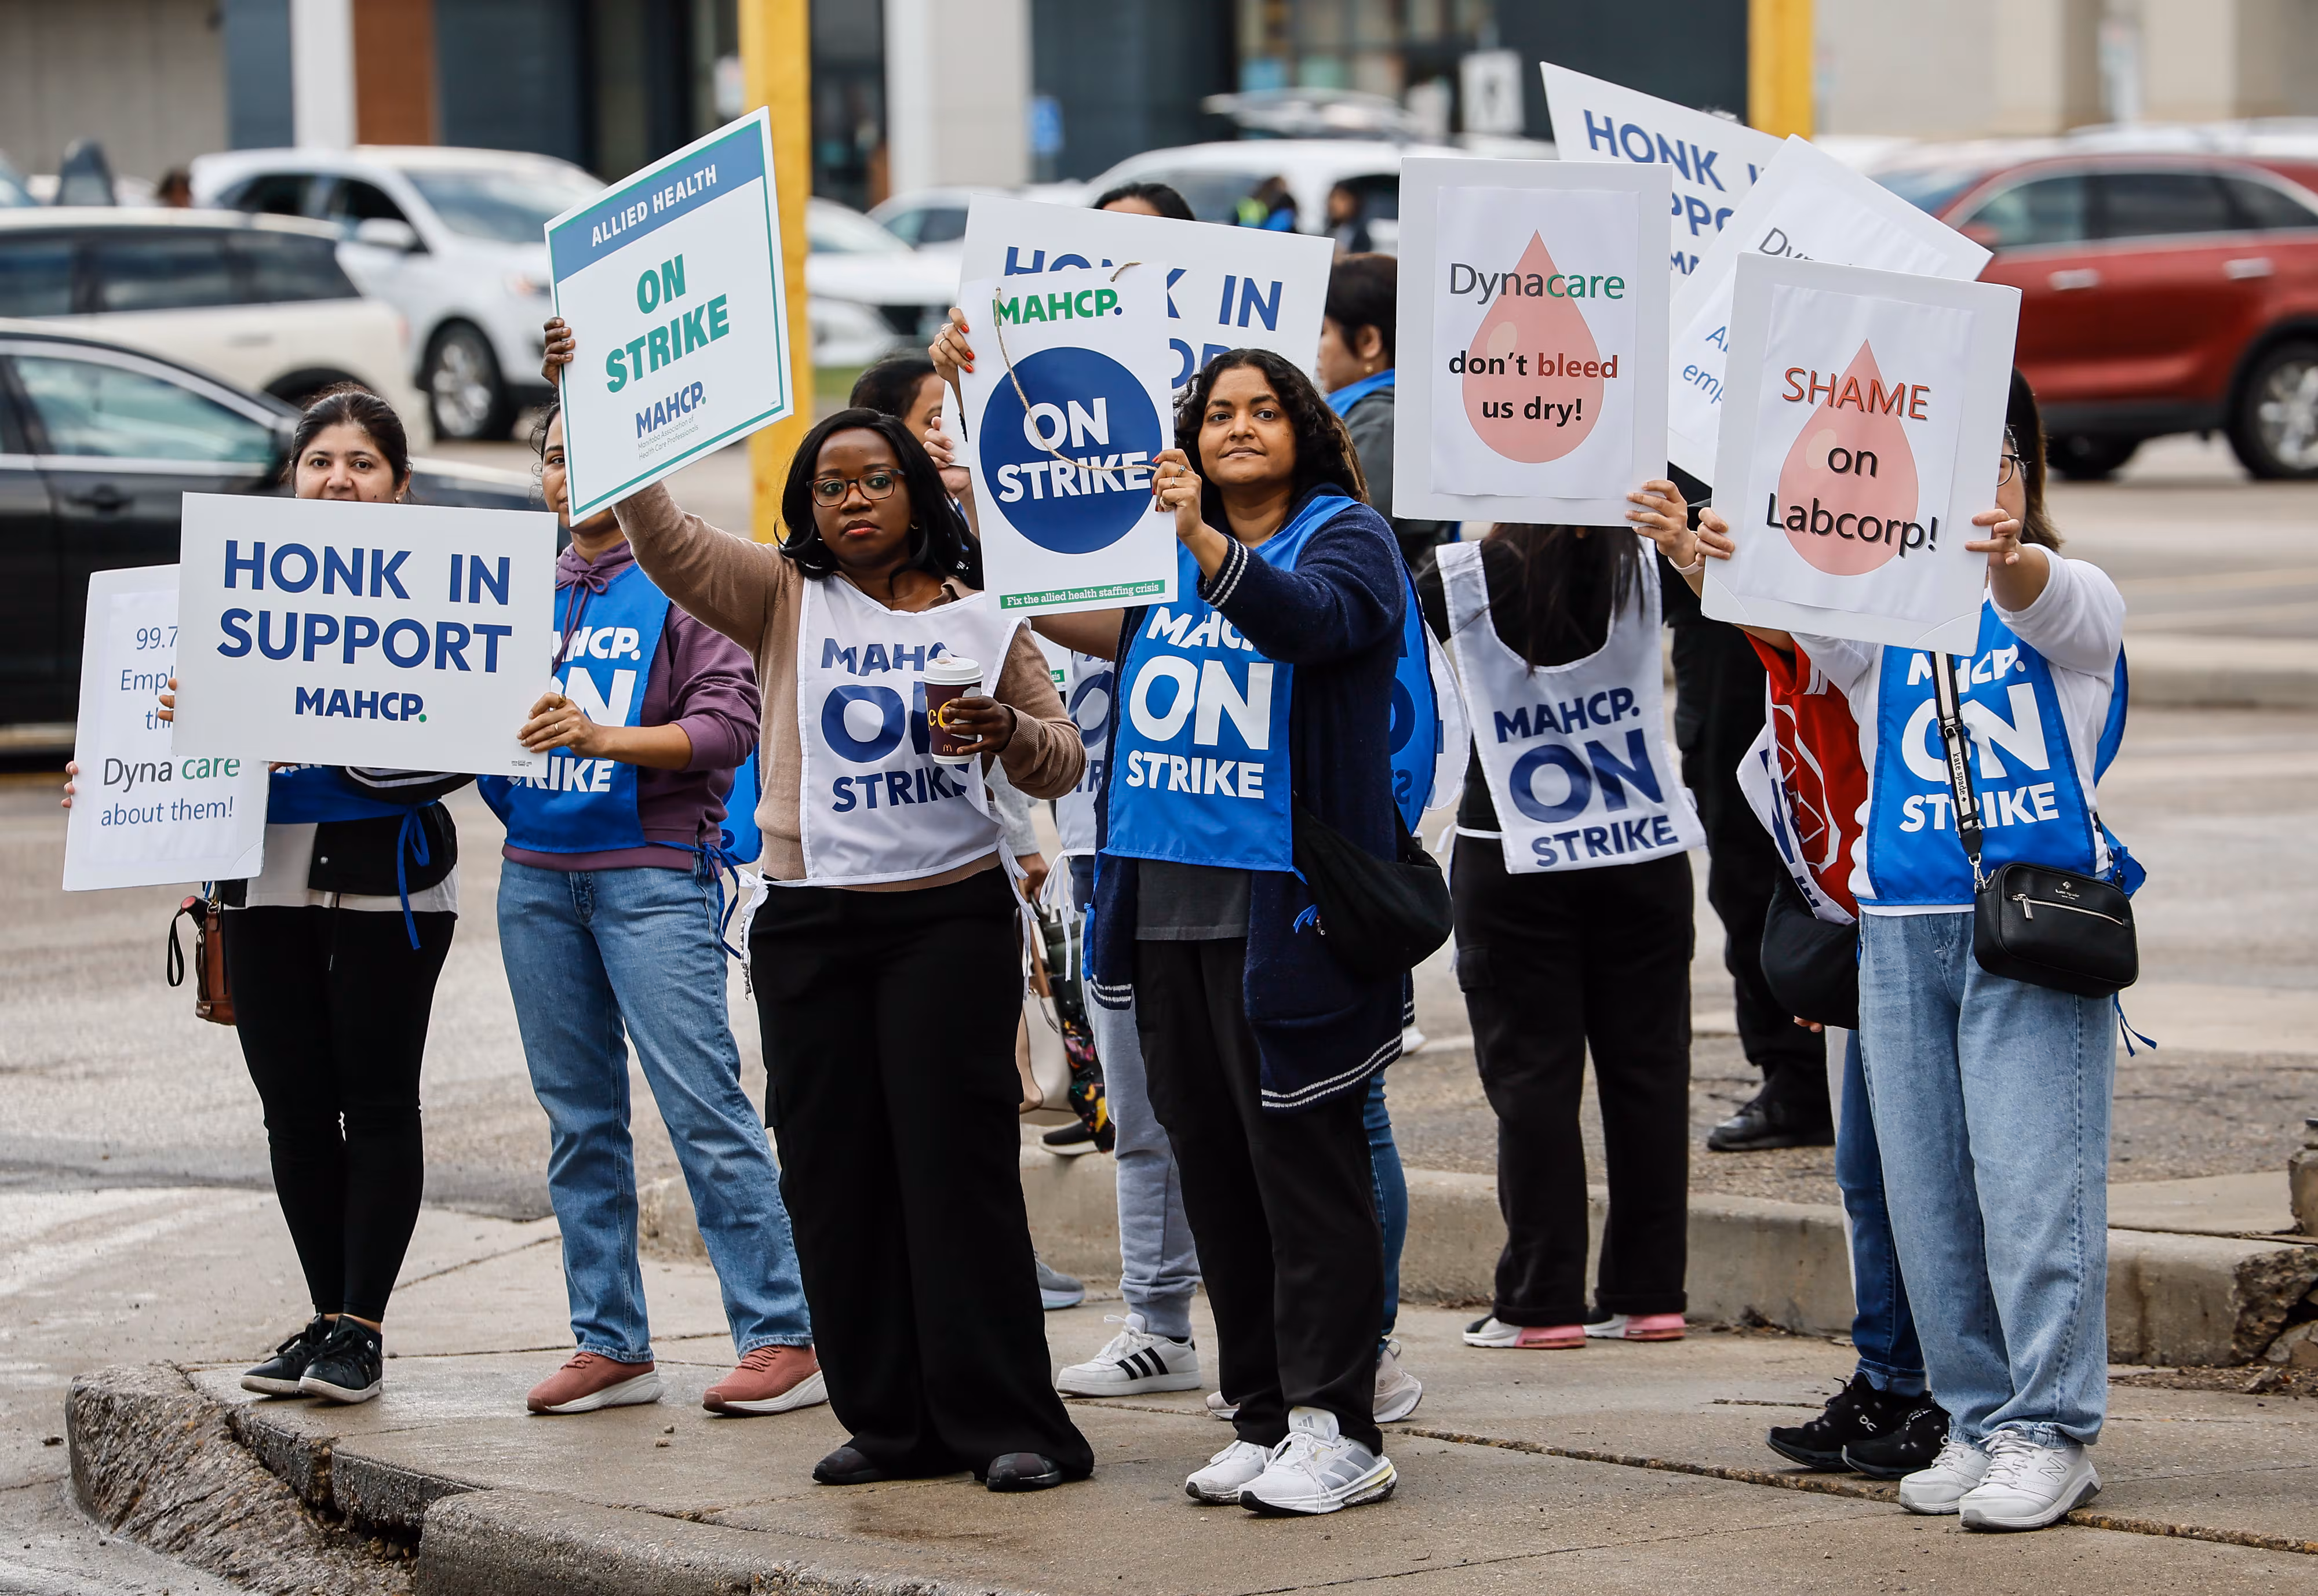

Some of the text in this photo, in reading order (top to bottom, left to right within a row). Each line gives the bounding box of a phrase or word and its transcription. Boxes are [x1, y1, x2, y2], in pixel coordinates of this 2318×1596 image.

[592, 164, 717, 247] ALLIED HEALTH
[637, 253, 686, 314] ON
[992, 289, 1122, 326] MAHCP.
[1218, 274, 1282, 331] IN
[1450, 263, 1625, 305] Dynacare
[606, 293, 730, 393] STRIKE
[1537, 352, 1619, 378] bleed
[636, 381, 706, 439] MAHCP.
[1482, 396, 1582, 427] us dry!
[1782, 367, 1931, 421] SHAME
[638, 414, 694, 450] Manitoba Association of
[639, 424, 699, 460] Health Care Professionals
[1023, 397, 1110, 451] ON
[997, 451, 1151, 502] STRIKE
[1828, 447, 1878, 479] on
[1766, 493, 1940, 559] Labcorp!
[224, 539, 511, 605] HONK IN
[1007, 582, 1159, 606] Fix the allied health staffing crisis
[217, 608, 512, 673] SUPPORT
[295, 686, 427, 722] MAHCP.
[1129, 655, 1274, 750] ON
[1493, 687, 1641, 744] MAHCP.
[103, 757, 240, 793] Dyna care
[1125, 750, 1265, 800] STRIKE
[1510, 728, 1665, 823] ON
[1953, 752, 1968, 795] kate spade
[101, 796, 234, 826] about them!
[1532, 814, 1679, 867] STRIKE
